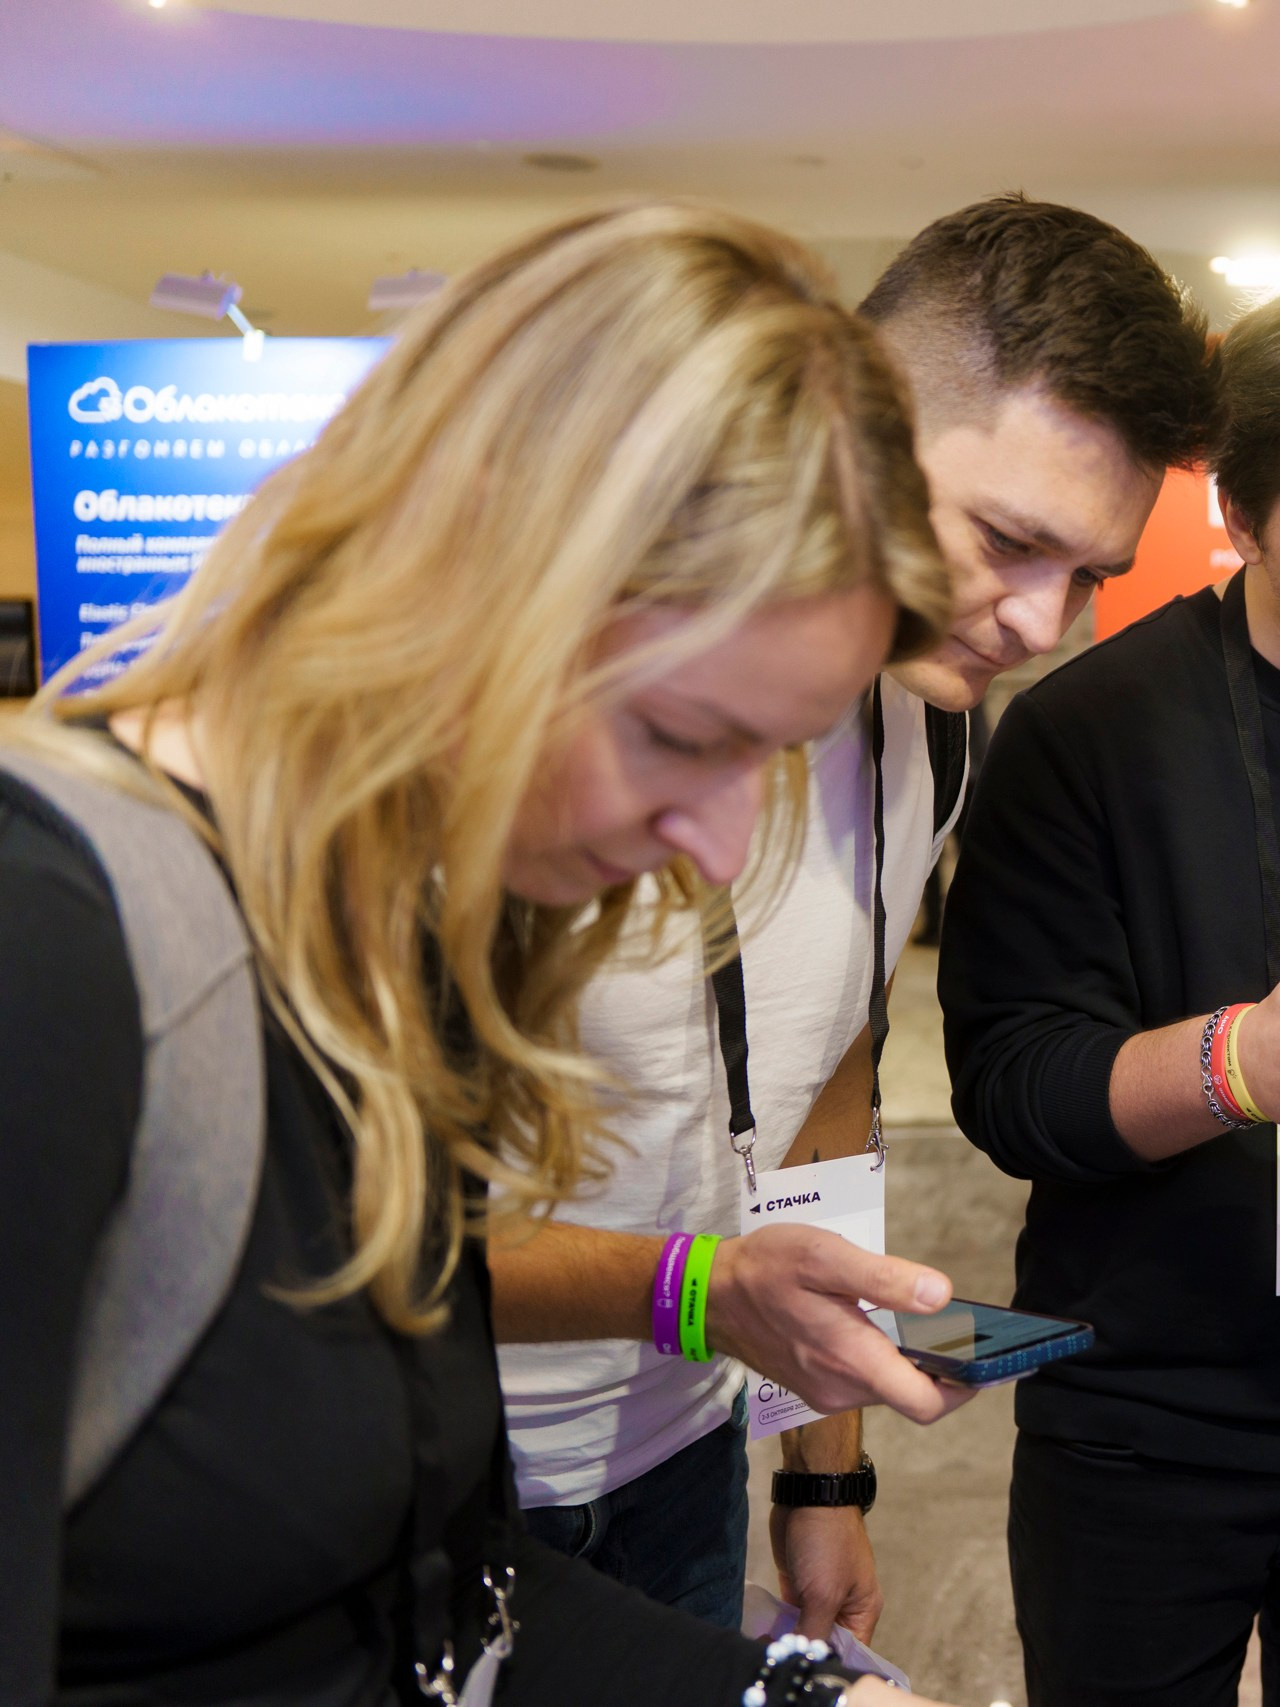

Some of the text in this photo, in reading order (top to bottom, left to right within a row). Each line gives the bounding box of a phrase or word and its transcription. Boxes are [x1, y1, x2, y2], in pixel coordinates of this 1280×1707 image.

[74, 488, 256, 522] Облакотек
[766, 1191, 821, 1212] СТАЧКА
[770, 1405, 794, 1418] ОКТЯБРЯ
